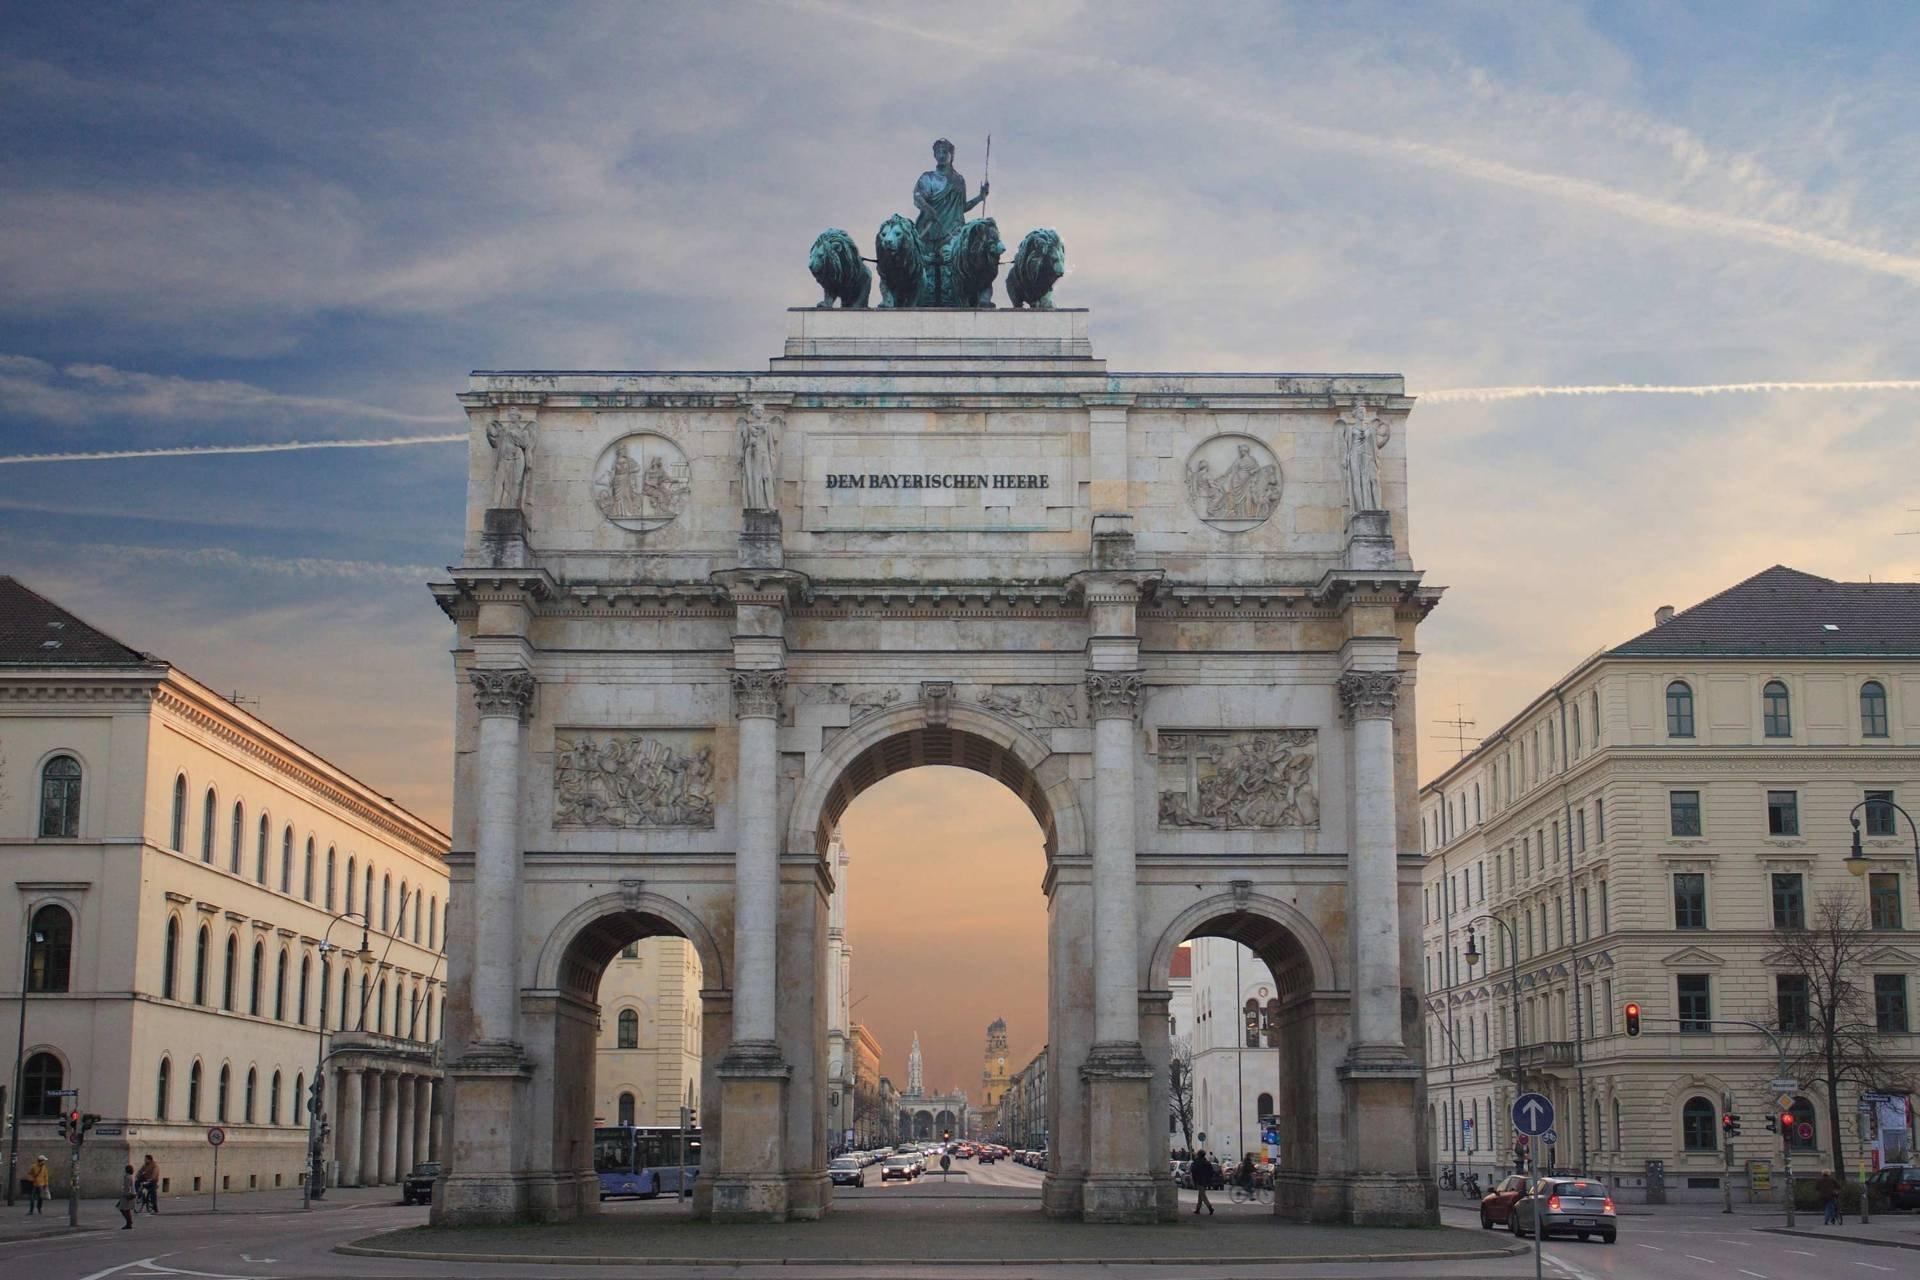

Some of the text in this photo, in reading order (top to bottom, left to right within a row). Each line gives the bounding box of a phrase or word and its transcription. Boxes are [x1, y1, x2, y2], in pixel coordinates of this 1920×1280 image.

[826, 474, 1049, 489] DEM BAYERISCHEN HEERE
